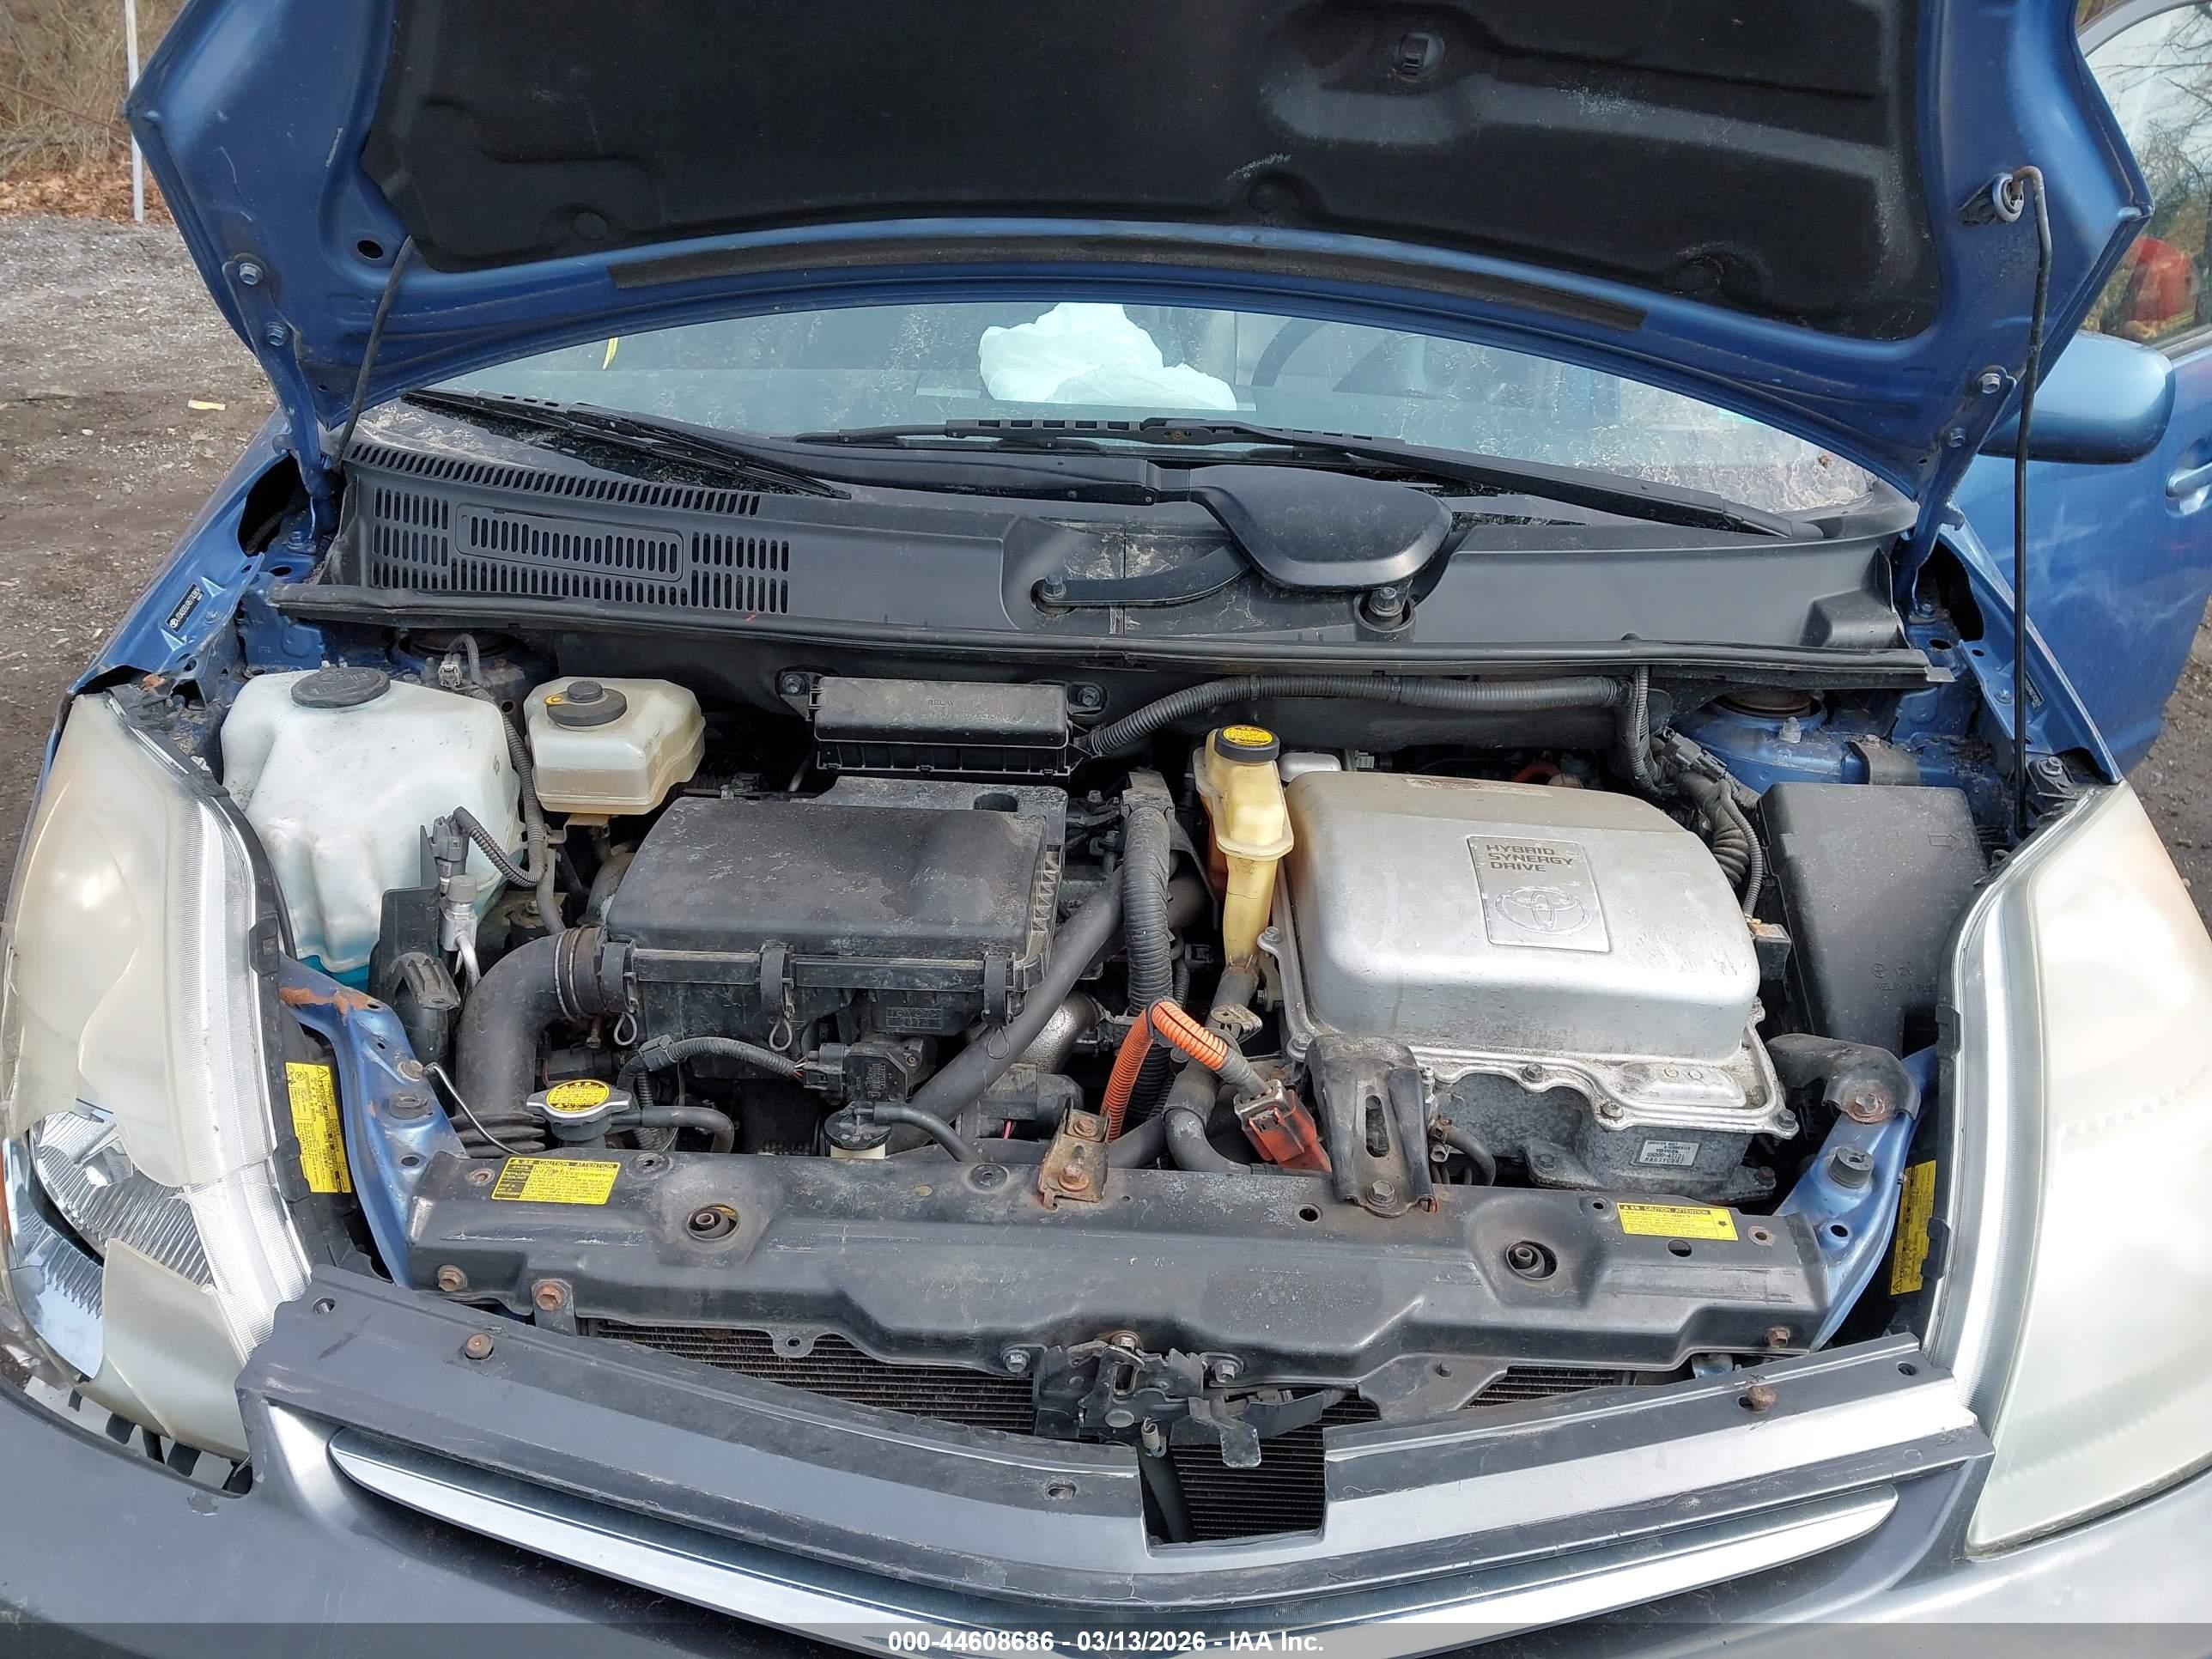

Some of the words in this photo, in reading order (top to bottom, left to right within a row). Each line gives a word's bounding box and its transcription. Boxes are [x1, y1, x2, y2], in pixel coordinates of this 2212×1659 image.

[1486, 844, 1555, 855] HYBRID
[1488, 853, 1573, 866] SYNERGY
[1491, 861, 1547, 872] DRIVE
